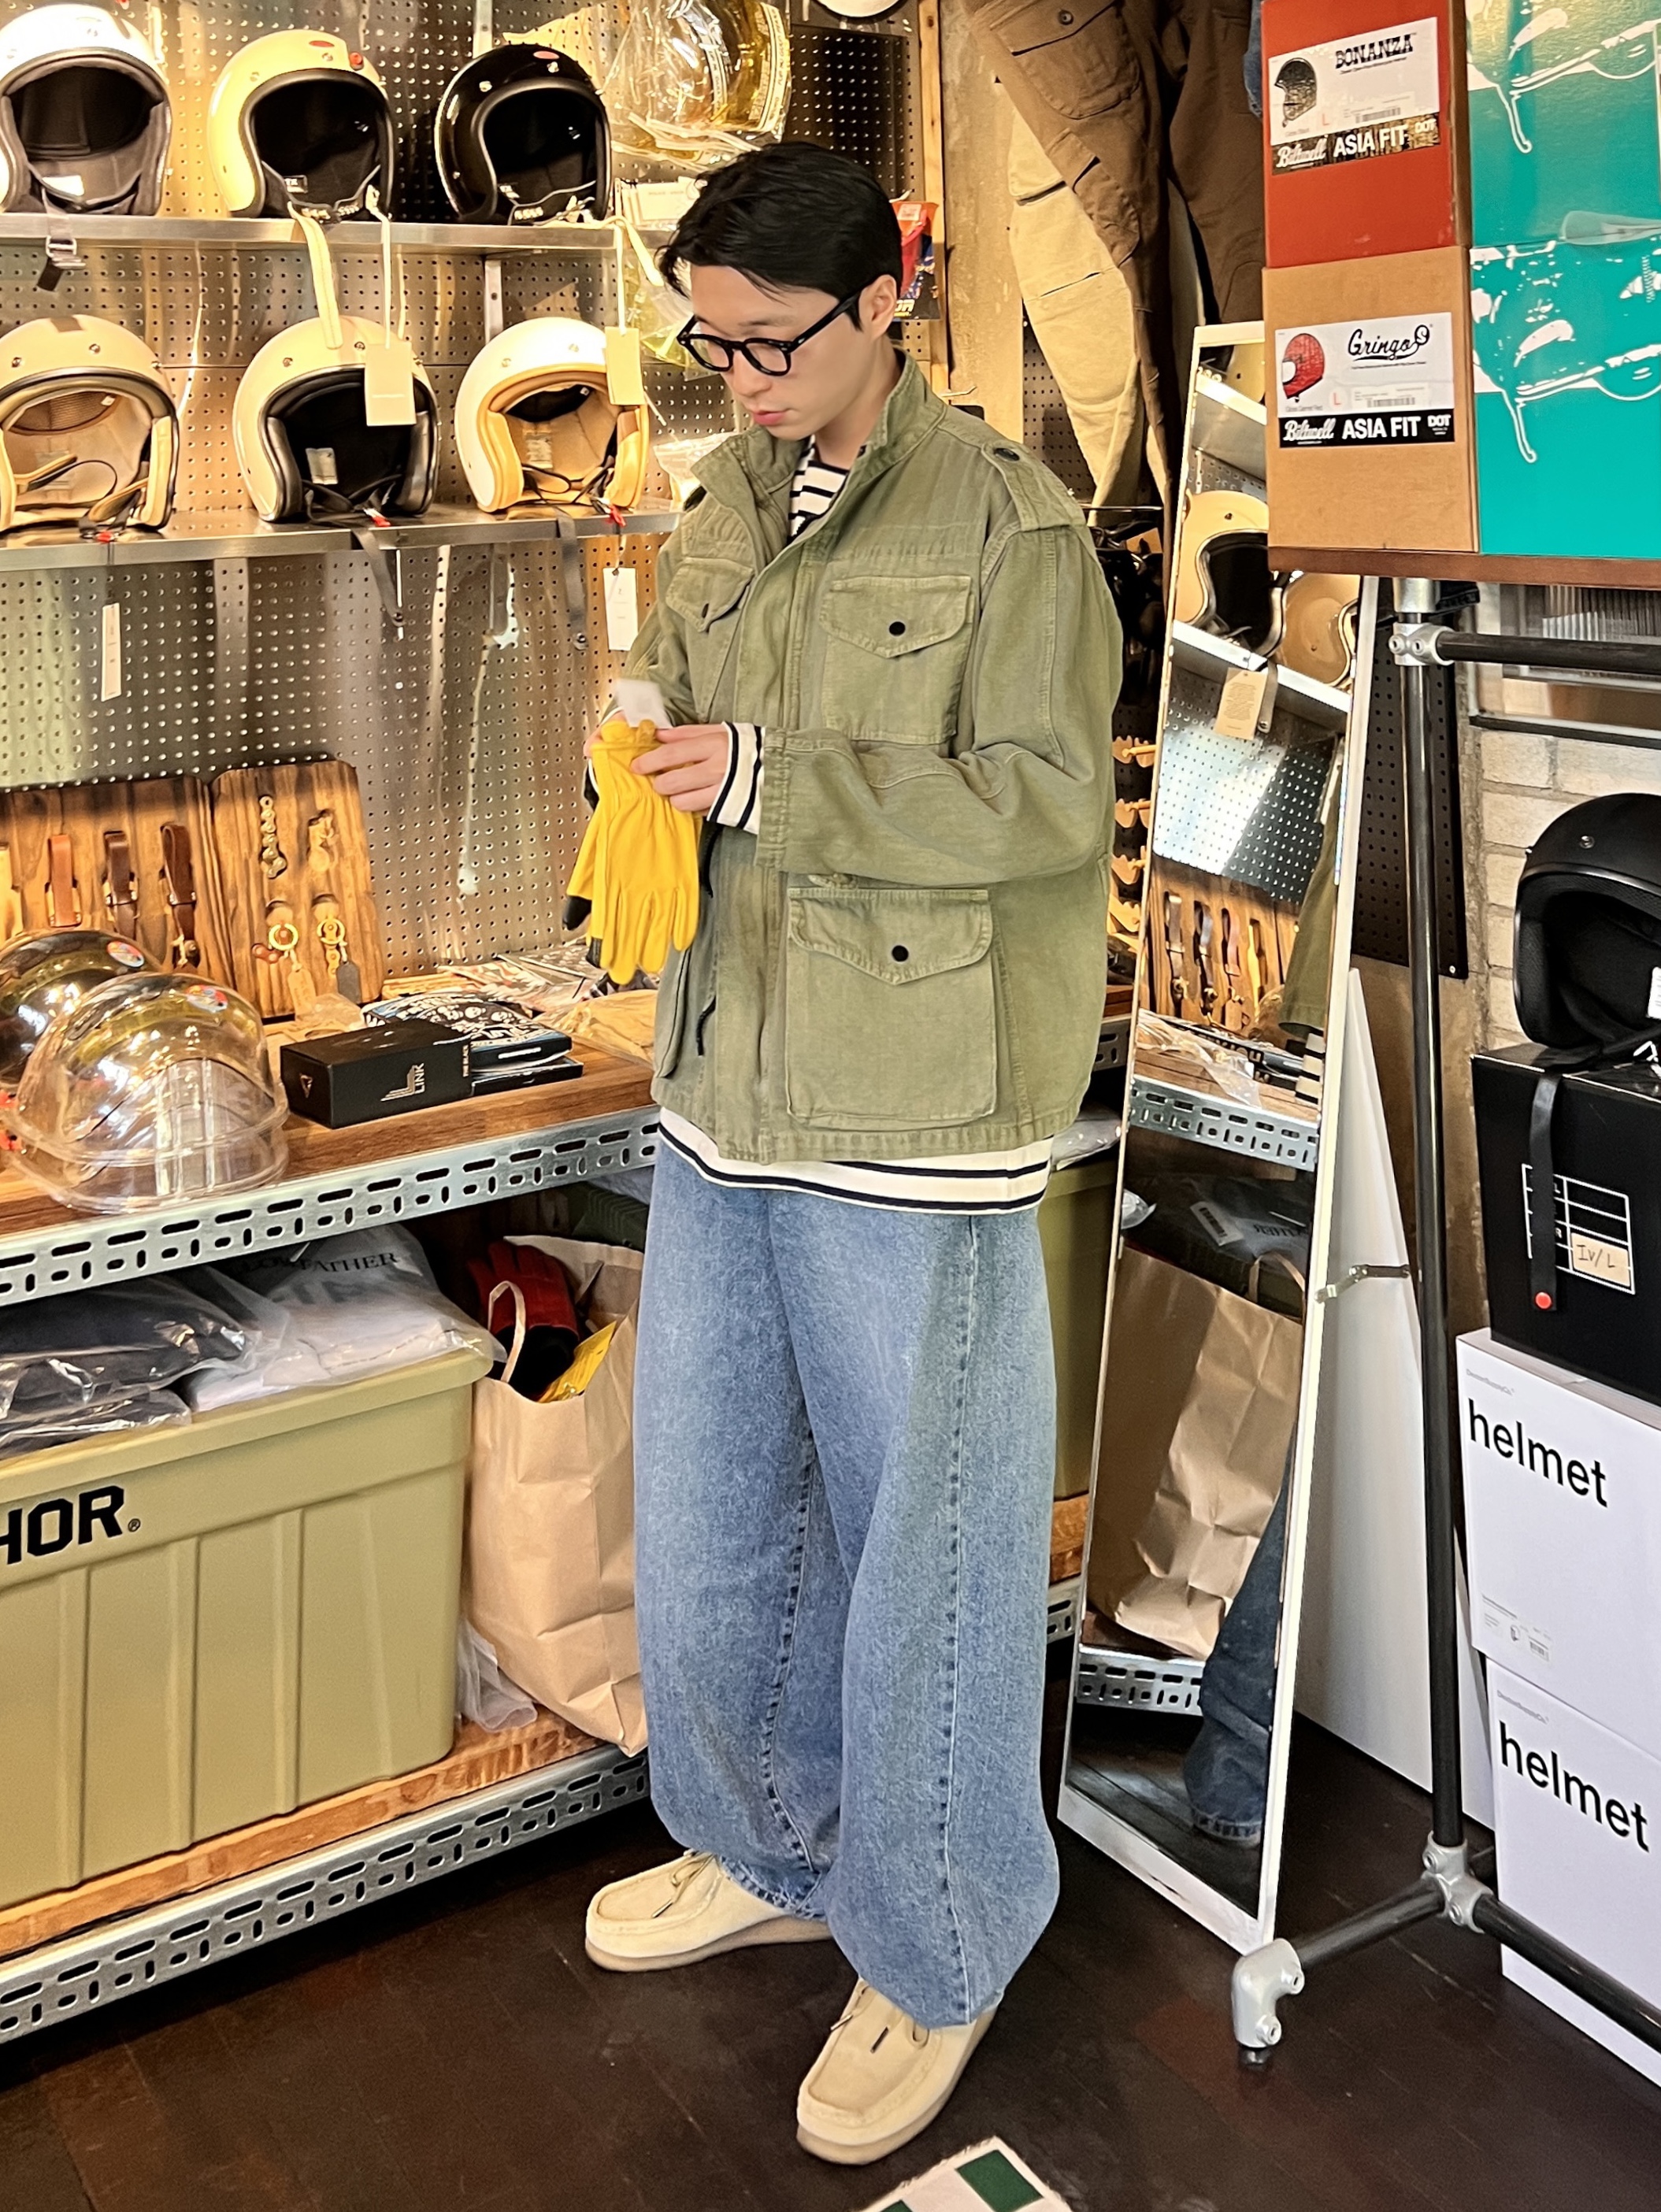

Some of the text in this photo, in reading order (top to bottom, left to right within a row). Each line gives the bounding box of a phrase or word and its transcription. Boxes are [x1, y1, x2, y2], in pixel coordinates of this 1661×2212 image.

[1335, 34, 1414, 69] BONANZA
[1333, 131, 1376, 158] ASIA
[1379, 124, 1409, 149] FIT
[1415, 118, 1437, 133] DOT
[1333, 392, 1341, 406] L
[1341, 417, 1388, 439] ASIA
[1390, 416, 1422, 437] FIT
[1427, 413, 1452, 427] DOT
[414, 1062, 425, 1095] LINK
[1468, 1398, 1608, 1508] helmet
[1499, 1719, 1650, 1854] helmet
